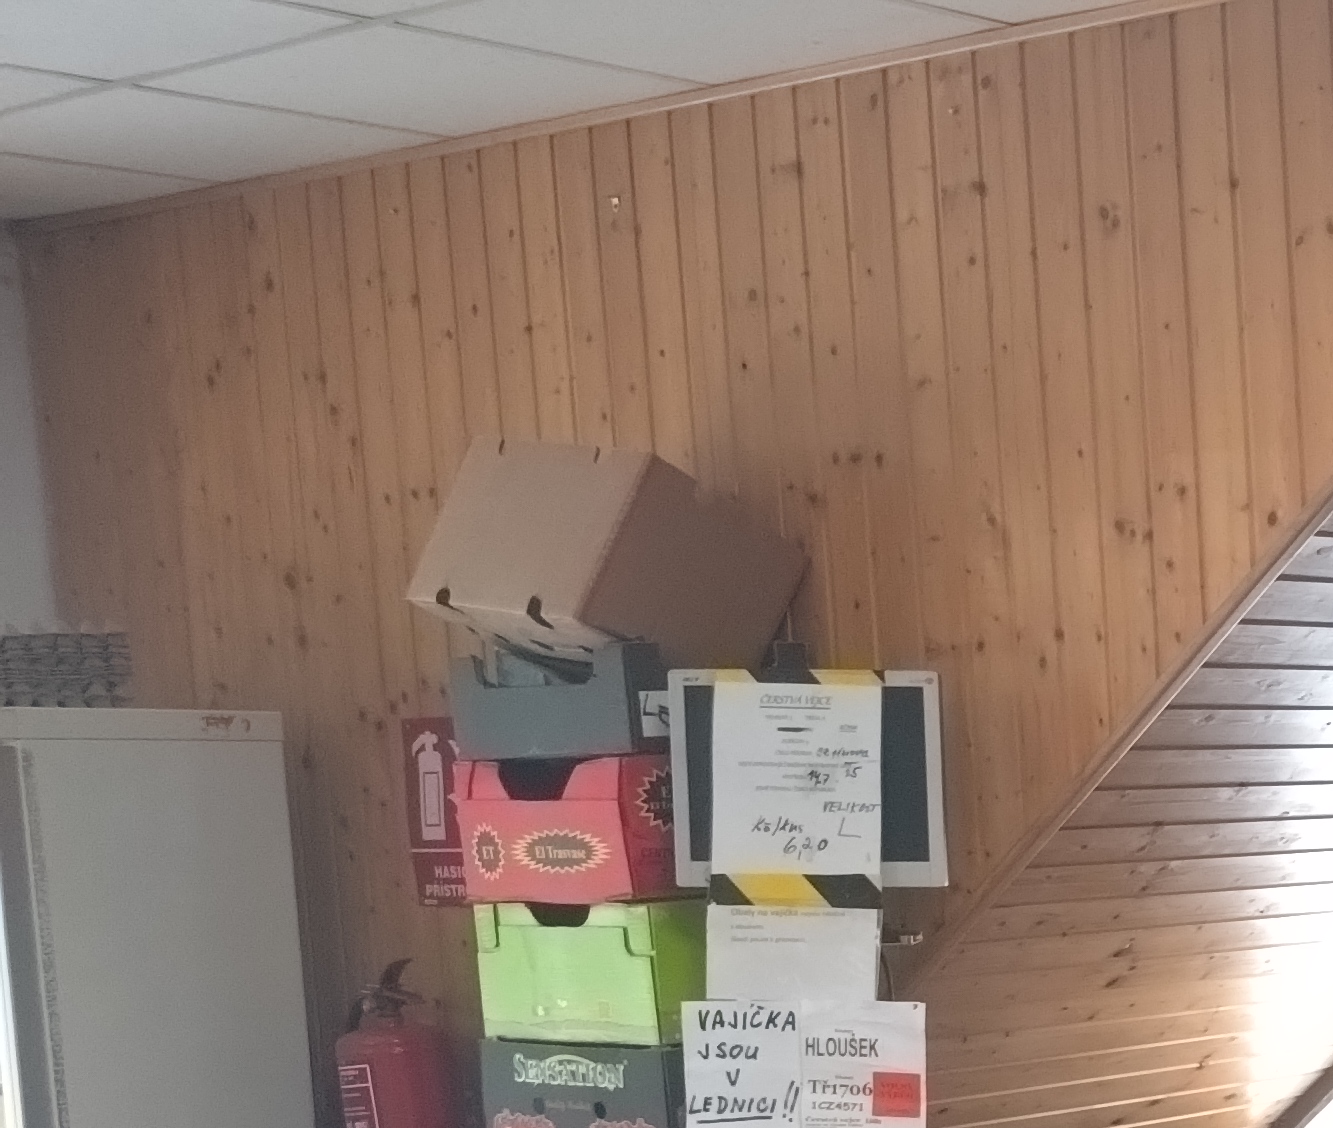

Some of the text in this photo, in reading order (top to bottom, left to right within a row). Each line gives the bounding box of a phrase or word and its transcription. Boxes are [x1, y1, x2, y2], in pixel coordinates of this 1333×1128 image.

[697, 1003, 797, 1033] VAJÍČKA
[697, 1042, 760, 1062] JSOU
[804, 1031, 880, 1059] HLOUŠEK
[688, 1094, 777, 1116] LEDNICI
